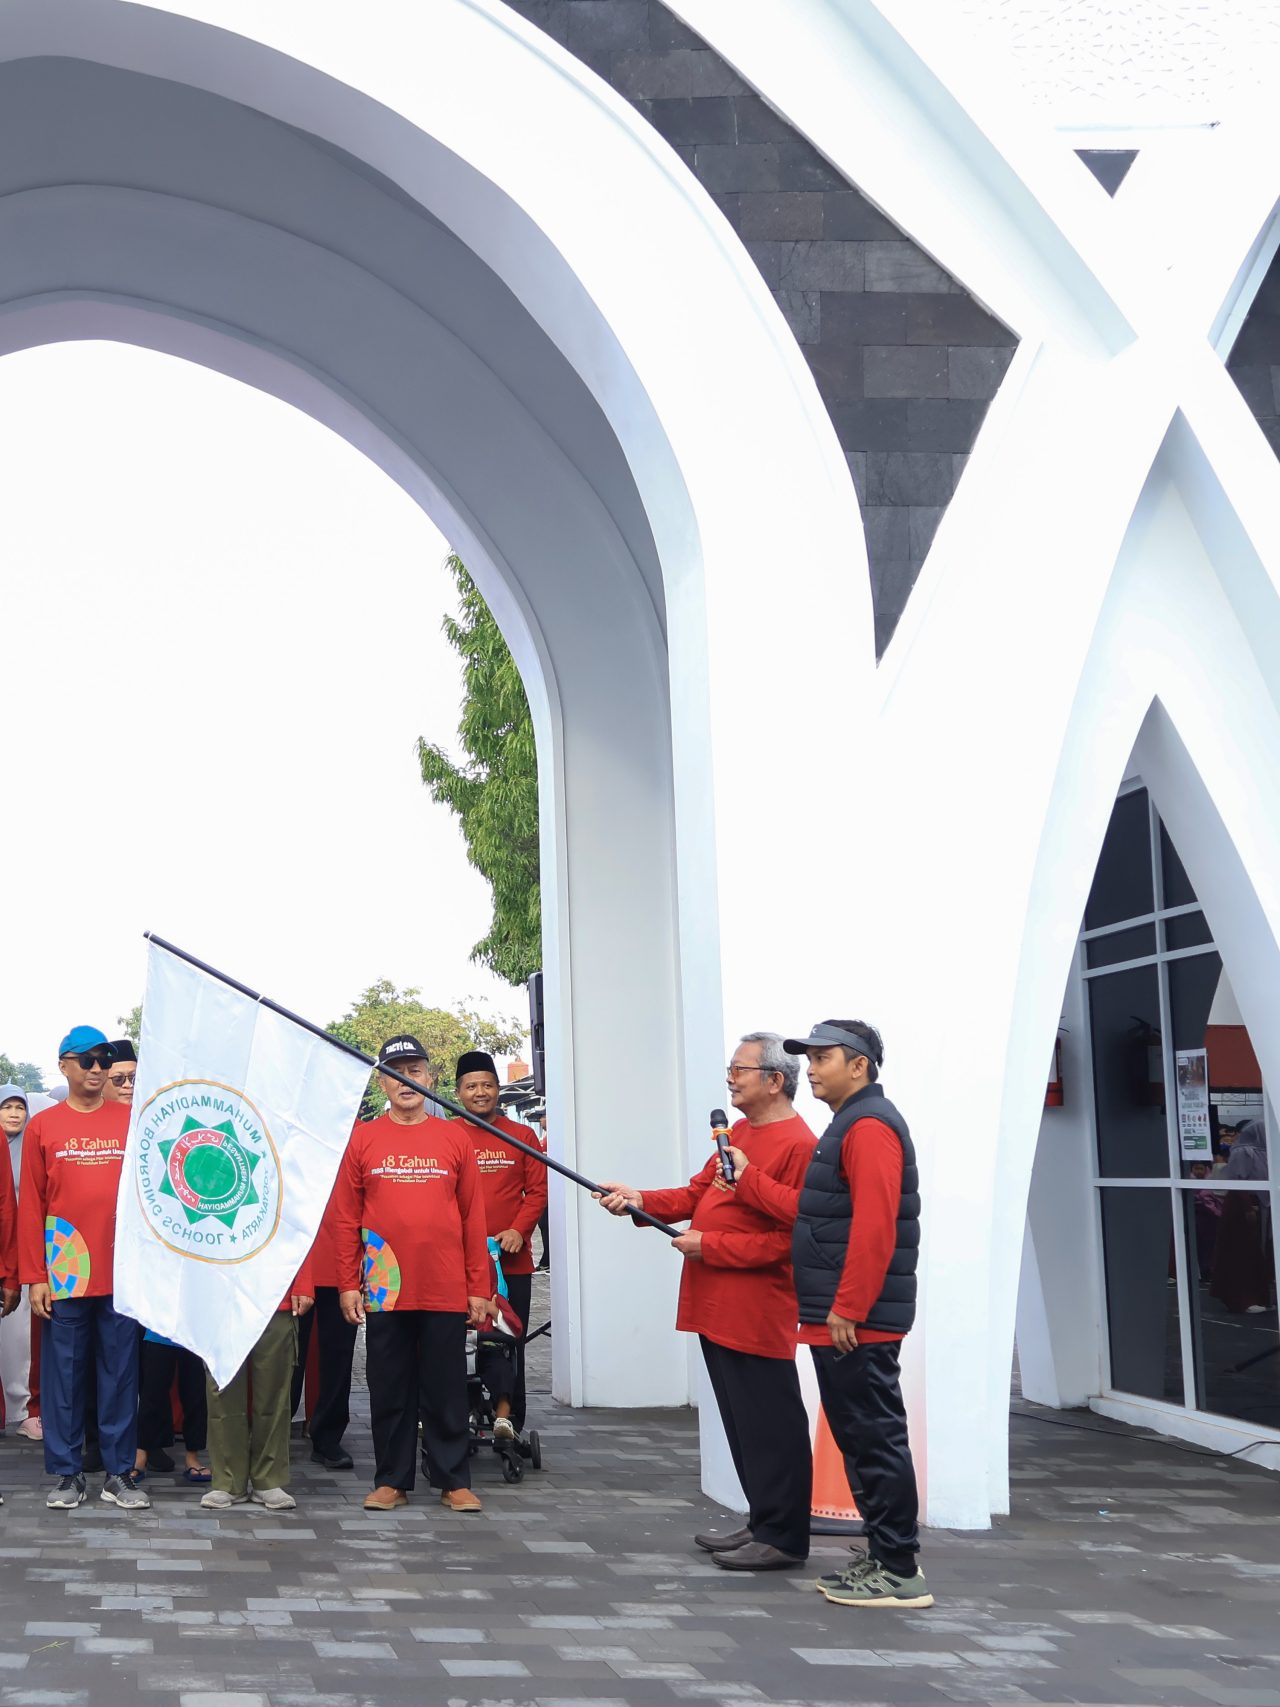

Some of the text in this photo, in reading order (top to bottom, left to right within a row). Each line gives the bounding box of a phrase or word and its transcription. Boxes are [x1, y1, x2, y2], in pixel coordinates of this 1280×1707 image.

[64, 1138, 120, 1150] 18 Tahun
[382, 1155, 438, 1168] 18 Tahun
